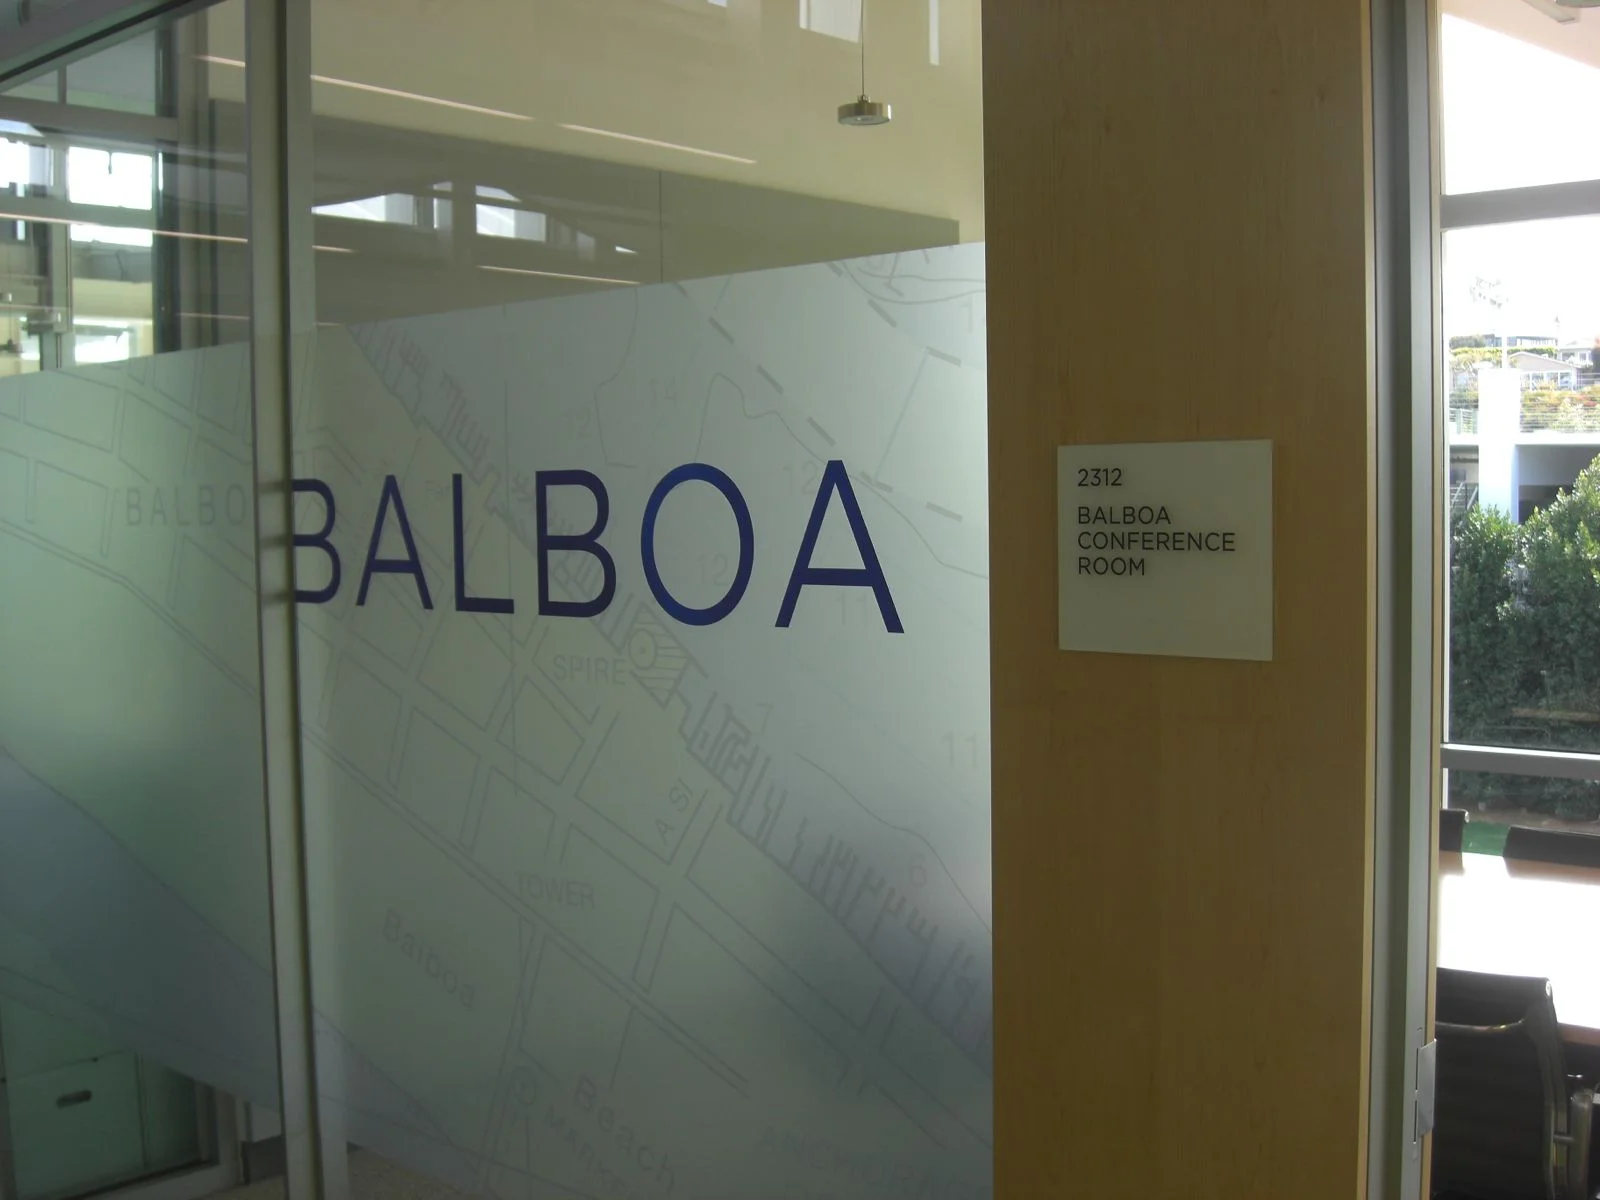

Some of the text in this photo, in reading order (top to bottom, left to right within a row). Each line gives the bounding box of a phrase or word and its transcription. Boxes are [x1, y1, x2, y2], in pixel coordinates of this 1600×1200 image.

[1077, 467, 1123, 487] 2312
[1077, 506, 1172, 525] BALBOA
[290, 458, 906, 636] BALBOA
[1077, 531, 1236, 552] CONFERENCE
[1077, 556, 1145, 576] ROOM
[552, 653, 627, 686] SPIRE
[516, 871, 596, 910] TOWER
[382, 906, 476, 1012] Balboa
[573, 1073, 677, 1196] Beach
